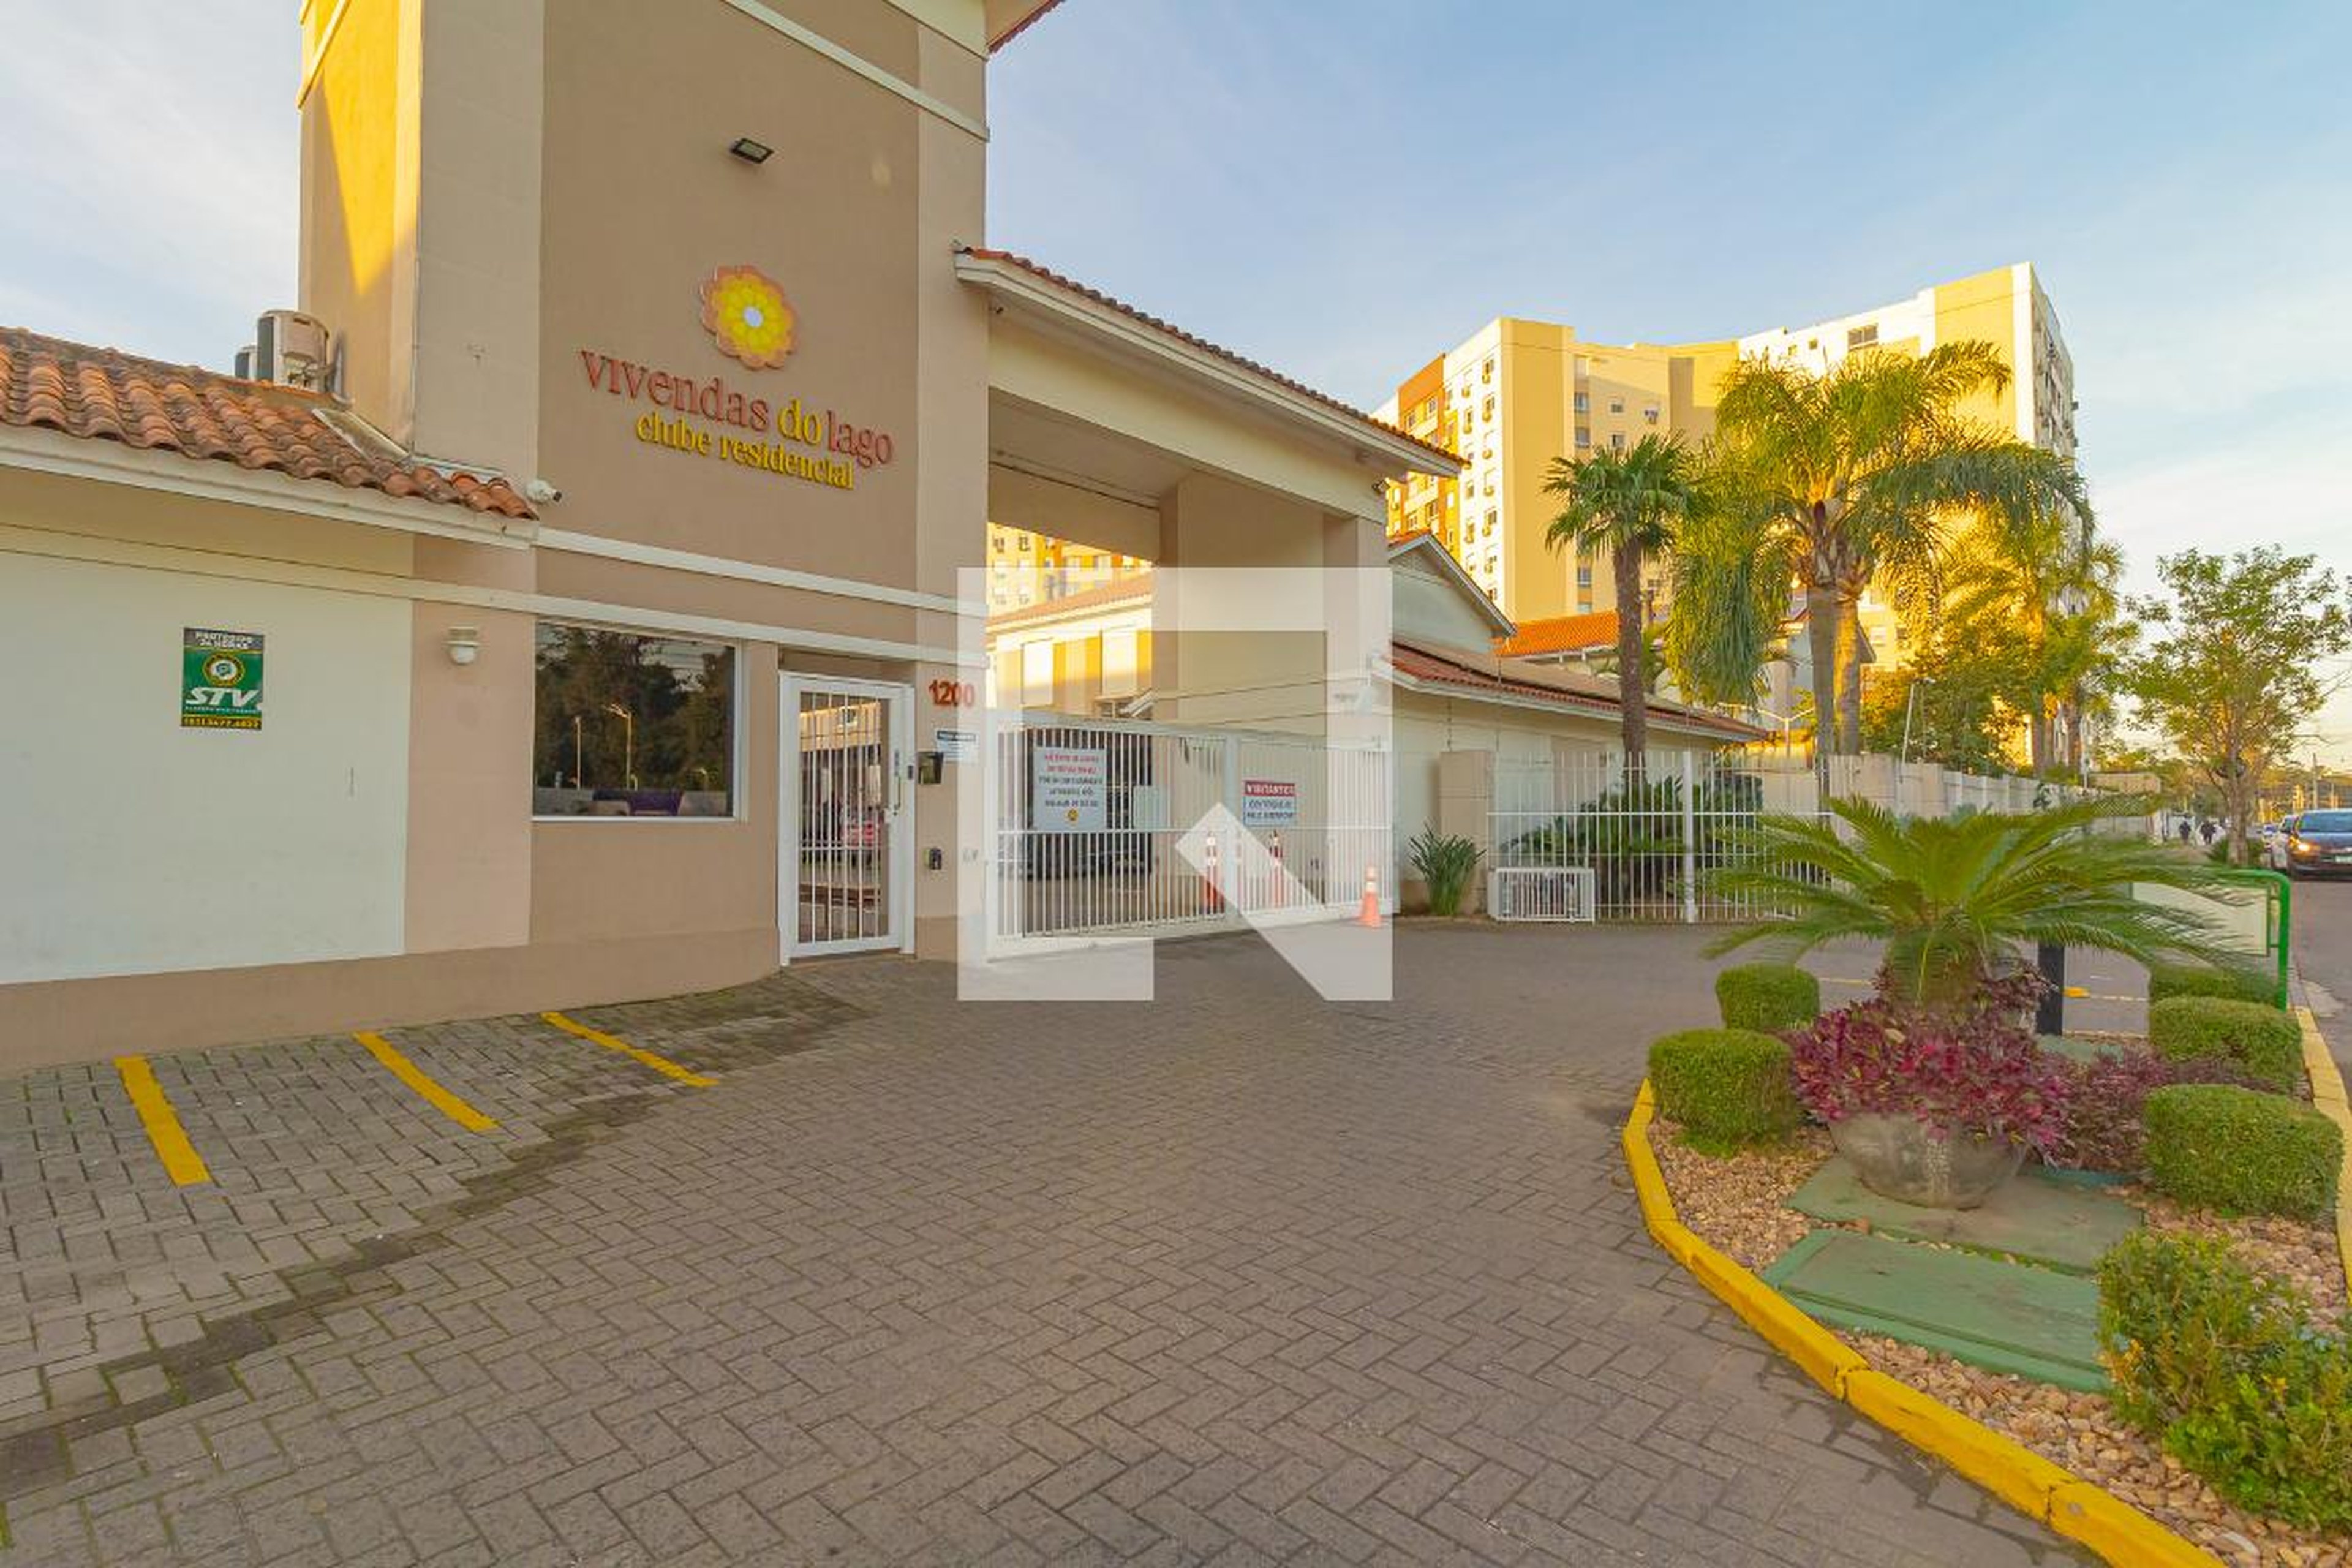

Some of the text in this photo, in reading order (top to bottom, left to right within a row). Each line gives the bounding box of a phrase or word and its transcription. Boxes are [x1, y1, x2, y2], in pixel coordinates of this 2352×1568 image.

[580, 350, 895, 468] vivendas do lago
[636, 412, 854, 490] clube residencial
[185, 687, 259, 707] STV
[928, 679, 975, 708] 1200
